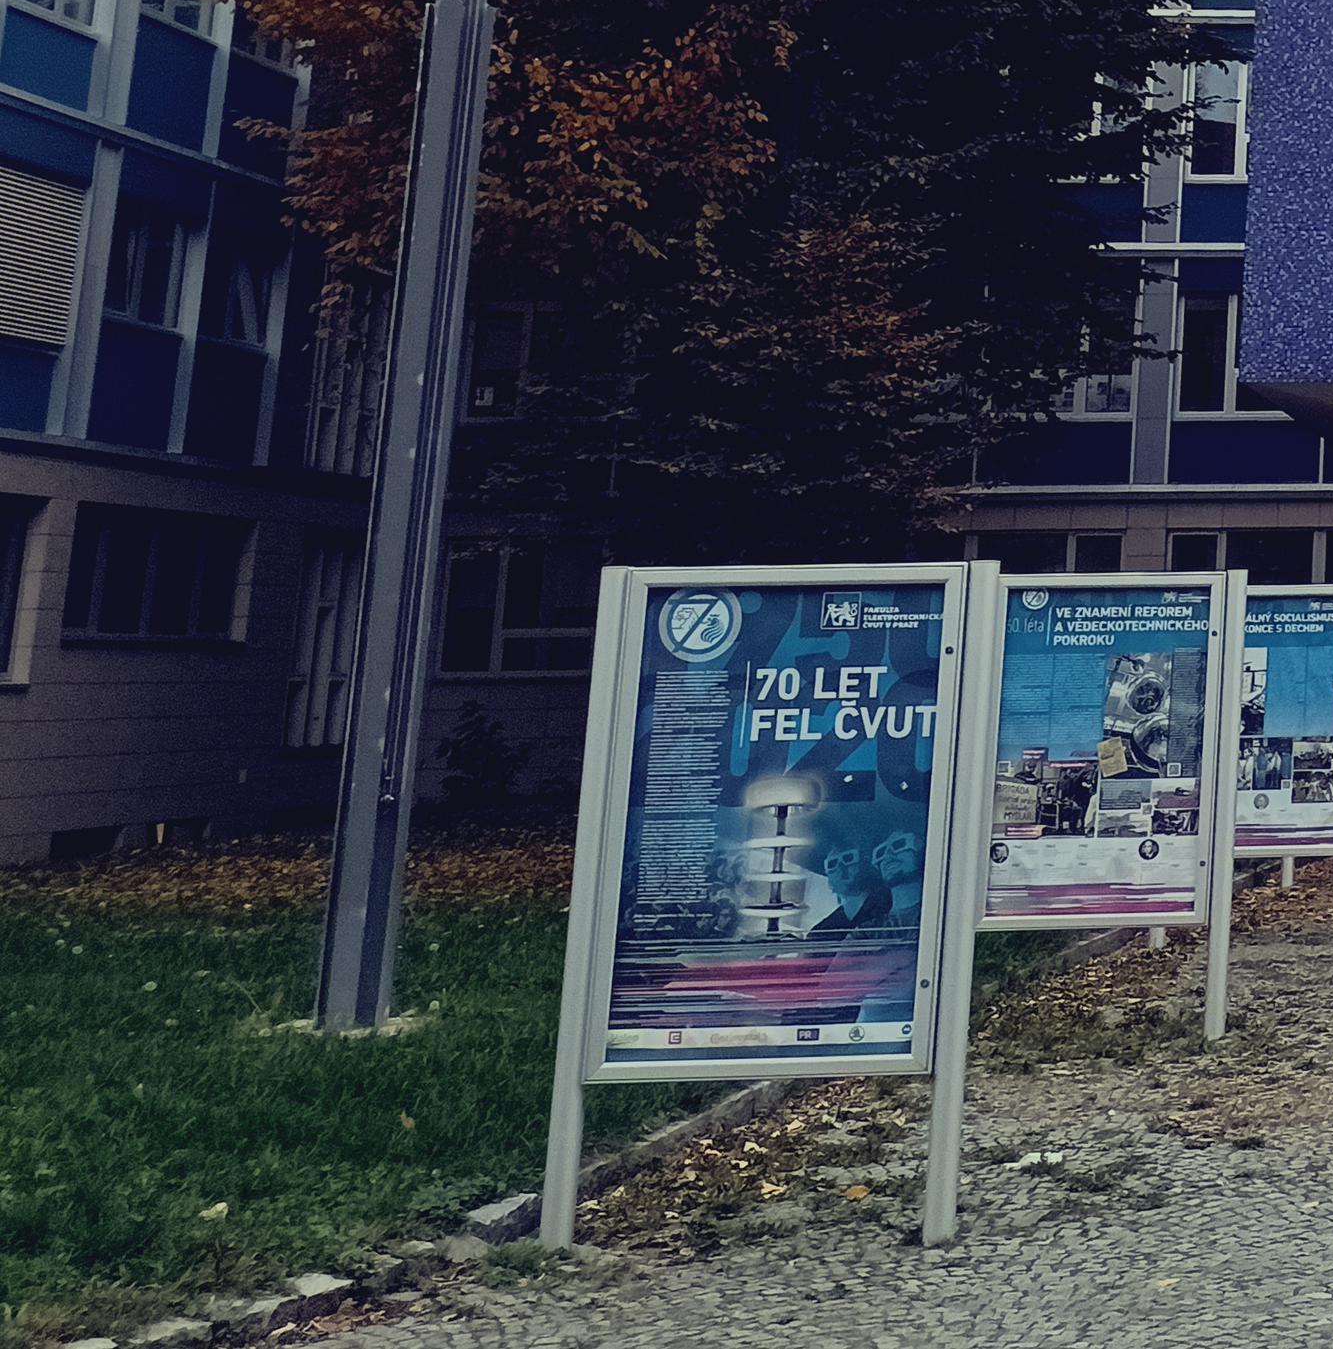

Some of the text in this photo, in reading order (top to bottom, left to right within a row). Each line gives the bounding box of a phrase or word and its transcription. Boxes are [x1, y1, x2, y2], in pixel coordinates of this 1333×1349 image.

[1056, 604, 1193, 618] VE ZNAMENÍ REFOREM
[1024, 617, 1045, 633] léta
[1054, 621, 1064, 632] A
[1275, 624, 1283, 633] S
[1053, 633, 1115, 646] POKROKU
[756, 666, 888, 701] 70 LET
[750, 700, 938, 742] FEL ČVUT
